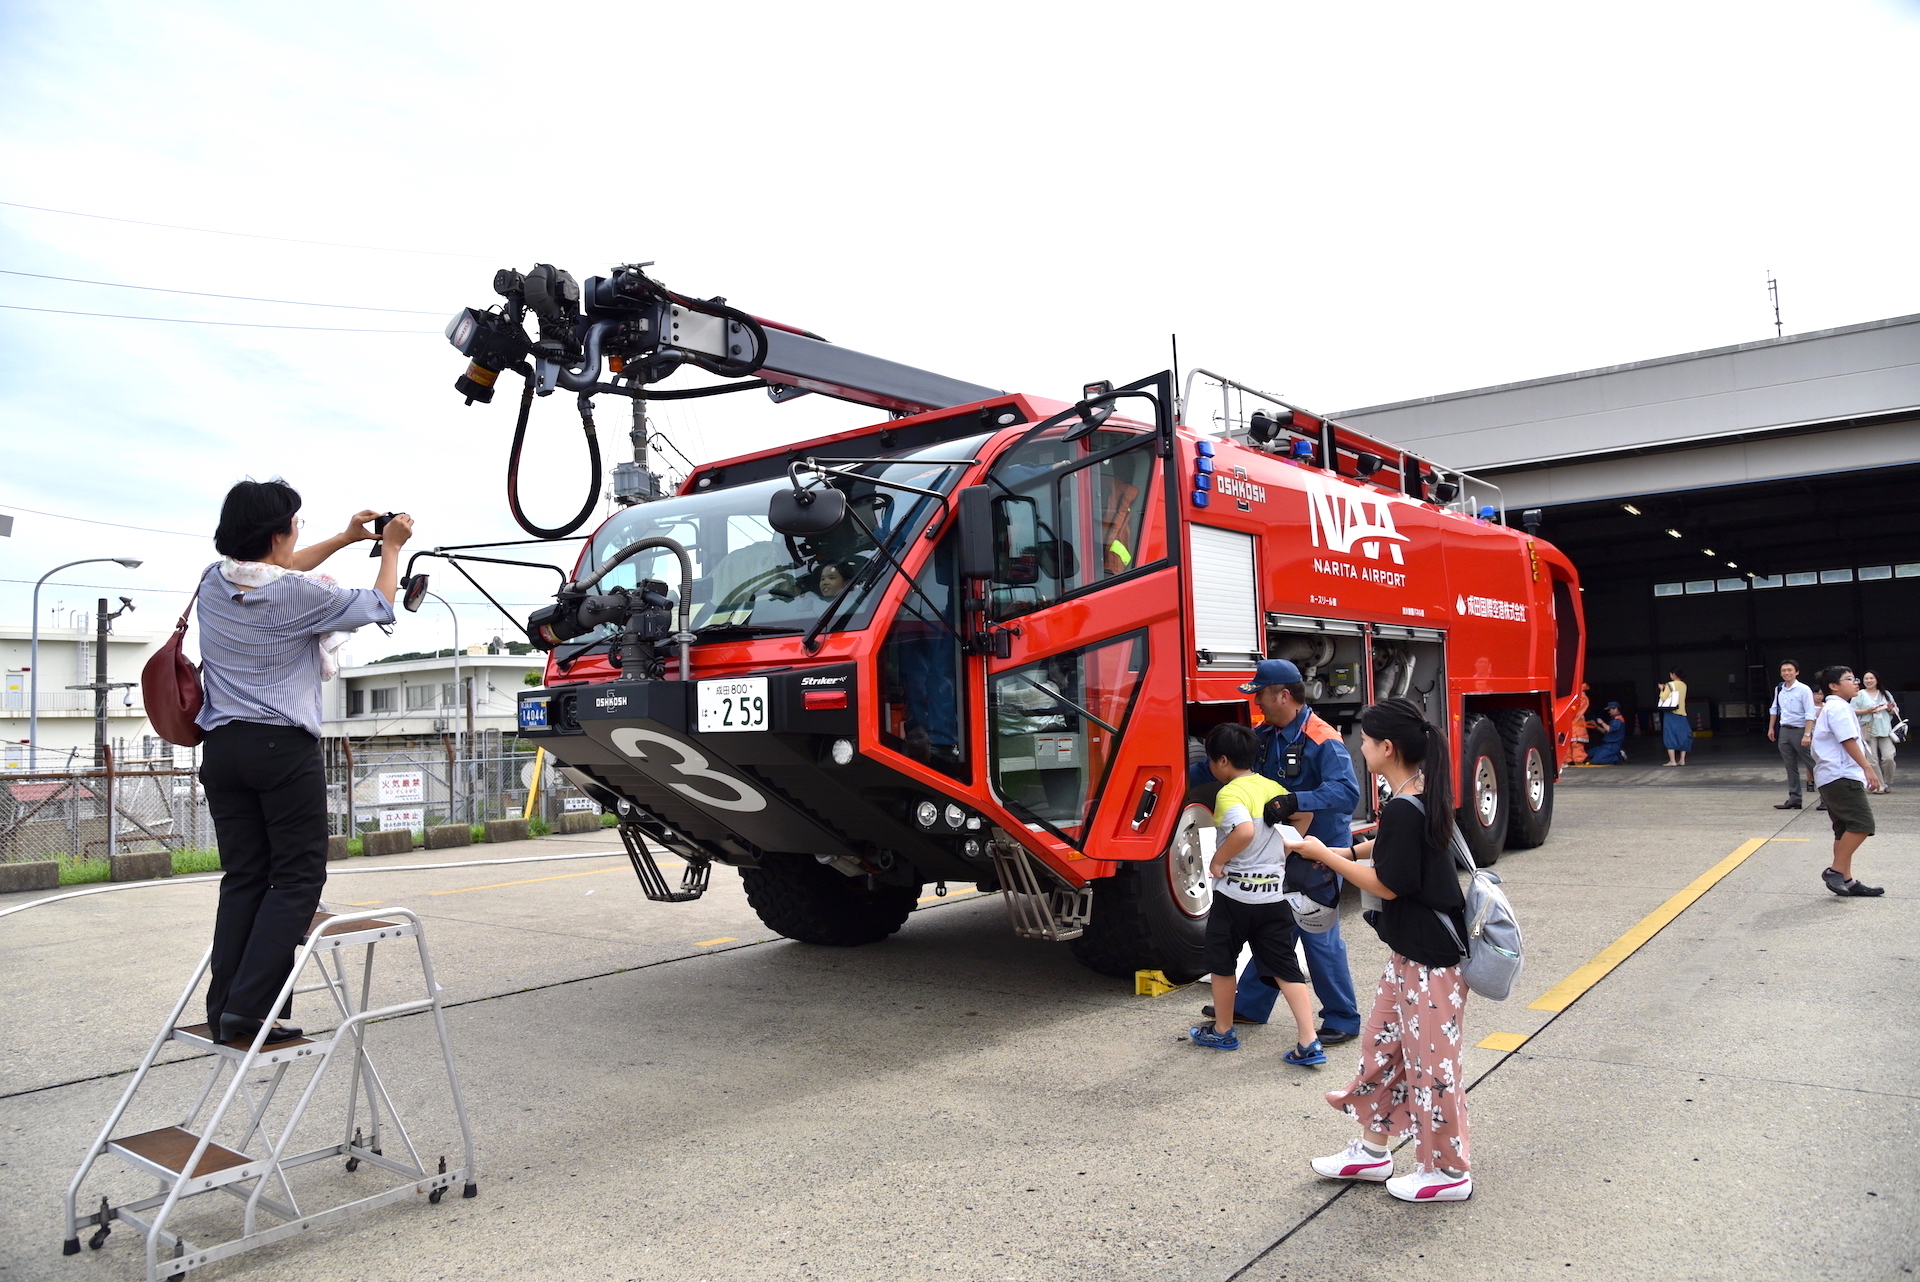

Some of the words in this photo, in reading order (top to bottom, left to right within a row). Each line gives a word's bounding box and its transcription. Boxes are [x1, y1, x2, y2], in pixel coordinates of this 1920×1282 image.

[1216, 475, 1267, 504] OSHKOSH
[1302, 472, 1411, 566] NAA
[1313, 558, 1358, 580] NARITA
[1361, 567, 1406, 588] AIRPORT
[1466, 595, 1527, 623] 成田国際空港株式会社
[801, 676, 838, 686] Striker
[595, 696, 628, 707] OSHKOSH
[522, 709, 545, 721] 14044
[610, 727, 768, 813] 3
[382, 778, 421, 789] 火気厳禁
[386, 812, 419, 821] 立入禁止
